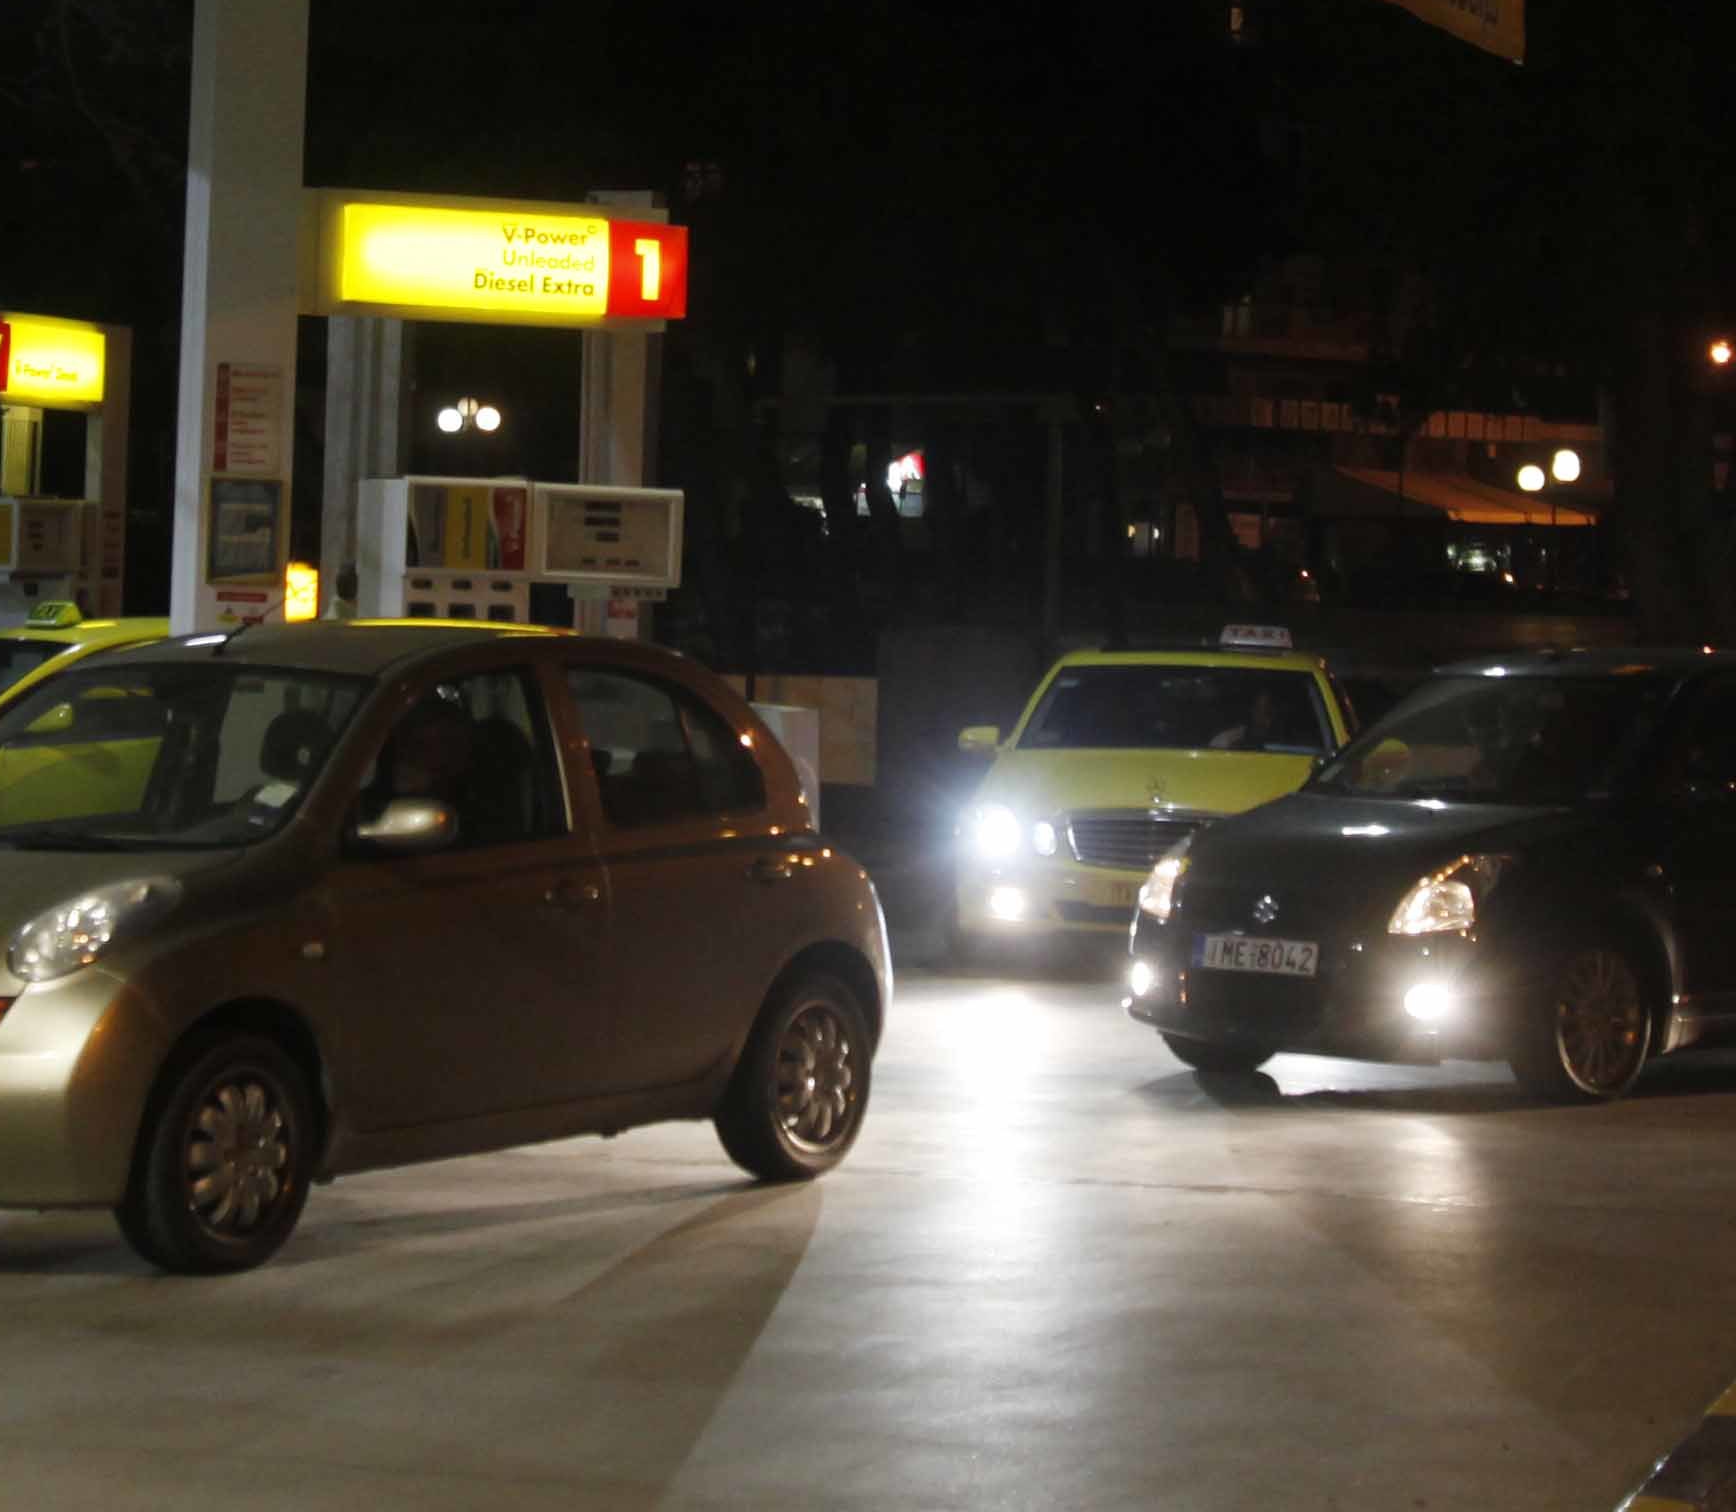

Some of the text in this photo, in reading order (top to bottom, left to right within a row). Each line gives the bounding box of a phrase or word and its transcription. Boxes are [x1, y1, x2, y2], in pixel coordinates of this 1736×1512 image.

[502, 225, 588, 246] V-Power
[502, 248, 595, 272] Unleaded
[634, 238, 662, 302] 1
[474, 271, 595, 297] Diesel Extra
